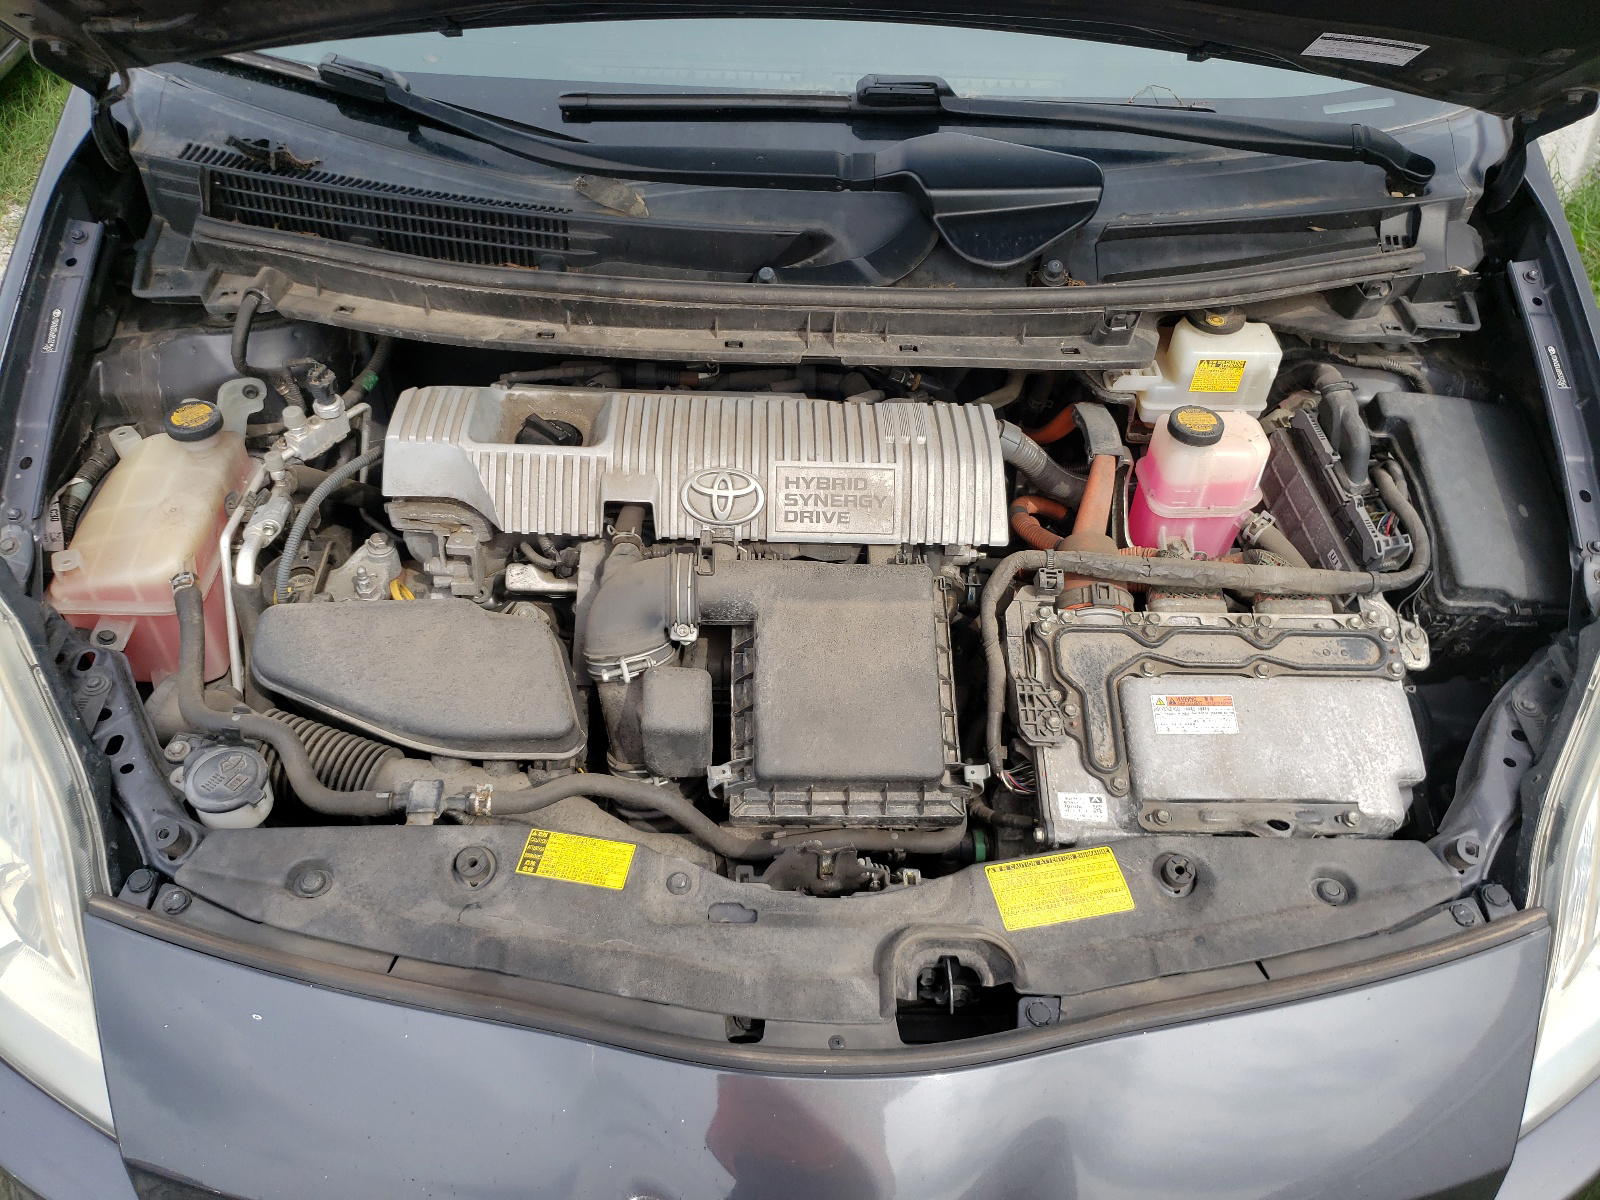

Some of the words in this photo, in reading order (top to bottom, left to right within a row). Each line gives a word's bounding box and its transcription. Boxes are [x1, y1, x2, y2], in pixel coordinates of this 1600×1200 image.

[784, 476, 868, 491] HYBRID
[784, 493, 888, 509] SYNERGY
[783, 510, 851, 524] DRIVE
